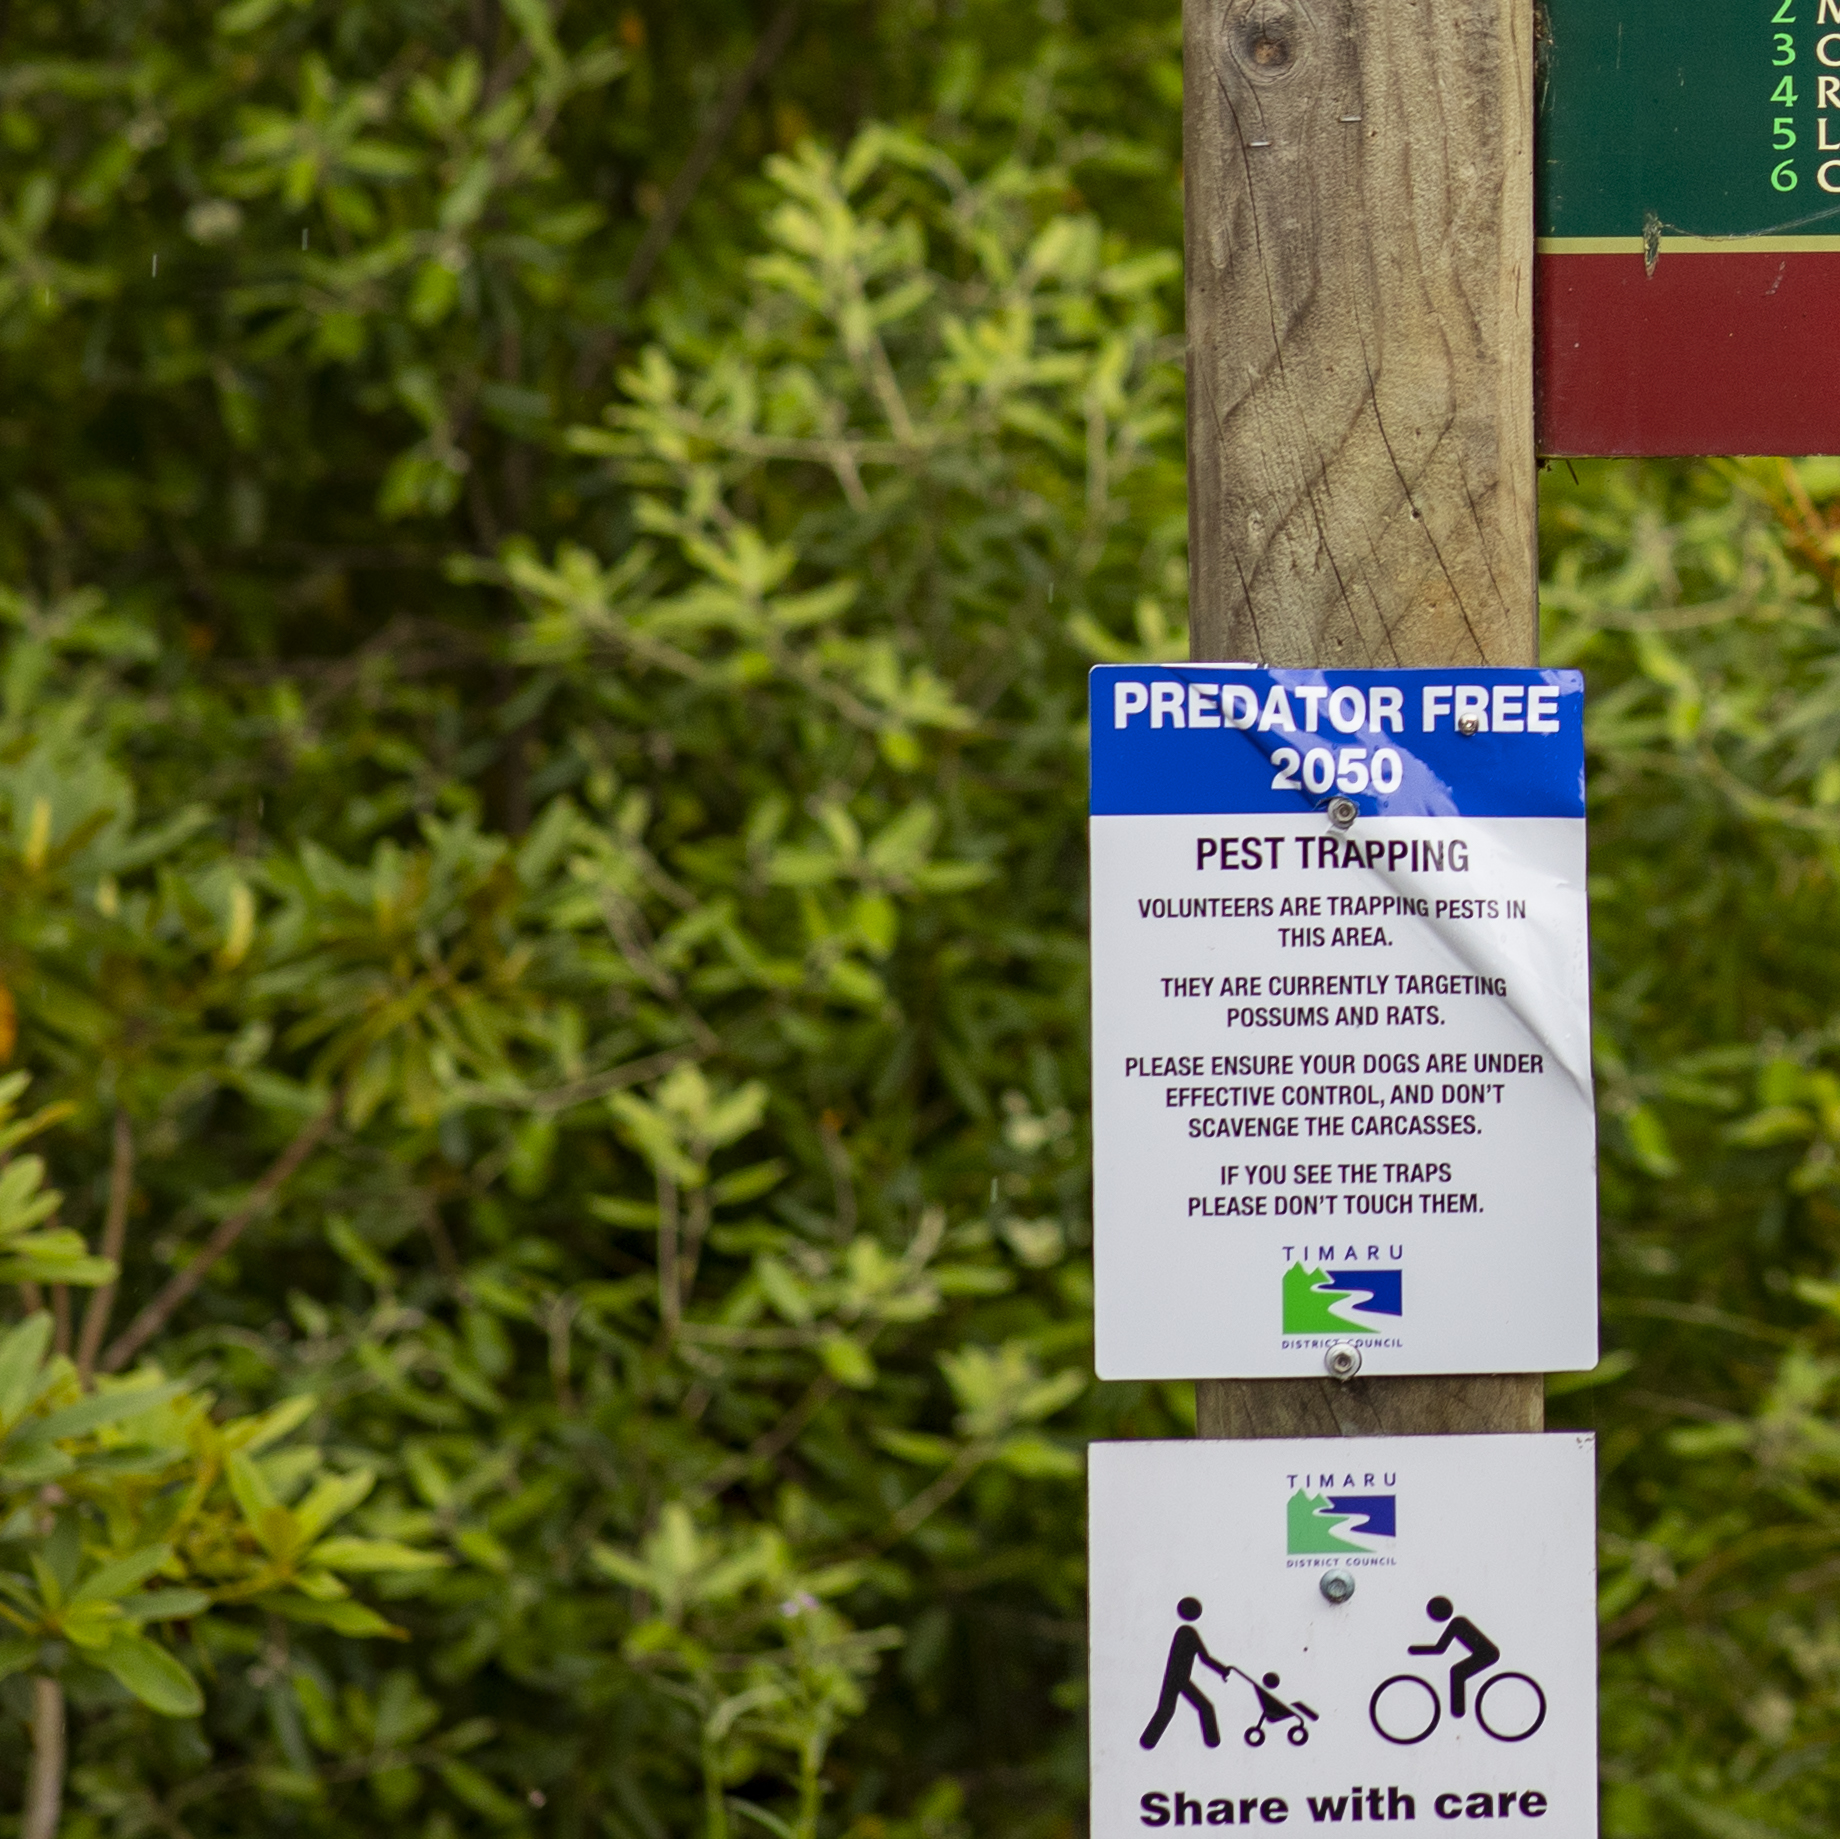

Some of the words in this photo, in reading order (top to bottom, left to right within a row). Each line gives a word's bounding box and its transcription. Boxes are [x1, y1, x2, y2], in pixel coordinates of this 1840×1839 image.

[1771, 32, 1797, 66] 3
[1769, 75, 1799, 108] 4
[1772, 117, 1797, 150] 5
[1770, 159, 1798, 192] 6
[1113, 680, 1405, 734] PREDATOR
[1422, 685, 1560, 733] FREE
[1270, 747, 1403, 795] 2050
[1196, 836, 1285, 871] PEST
[1295, 836, 1470, 873] TRAPPING
[1138, 896, 1275, 919] VOLUNTEERS
[1279, 896, 1322, 917] ARE
[1327, 895, 1429, 918] TRAPPING
[1435, 898, 1503, 919] PESTS
[1507, 900, 1526, 920] IN
[1278, 927, 1326, 948] THIS
[1331, 926, 1393, 947] AREA.
[1161, 976, 1215, 998] THEY
[1220, 976, 1263, 997] ARE
[1268, 975, 1391, 997] CURRENTLY
[1395, 975, 1508, 997] TARGETING
[1226, 1006, 1329, 1028] POSSUMS
[1335, 1005, 1380, 1027] AND
[1385, 1005, 1445, 1027] RATS.
[1125, 1056, 1205, 1078] PLEASE
[1210, 1055, 1294, 1077] ENSURE
[1298, 1054, 1356, 1076] YOUR
[1362, 1053, 1421, 1075] DOGS
[1425, 1053, 1469, 1074] ARE
[1473, 1053, 1544, 1075] UNDER
[1165, 1086, 1276, 1108] EFFECTIVE
[1281, 1084, 1386, 1109] CONTROL,
[1390, 1084, 1435, 1105] AND
[1188, 1117, 1299, 1139] SCAVENGE
[1304, 1116, 1345, 1137] THE
[1350, 1114, 1482, 1136] CARCASSES.
[1220, 1165, 1240, 1185] IF
[1244, 1165, 1289, 1186] YOU
[1293, 1164, 1333, 1185] SEE
[1337, 1163, 1378, 1184] THE
[1382, 1162, 1452, 1184] TRAPS
[1188, 1195, 1268, 1217] PLEASE
[1343, 1194, 1413, 1215] TOUCH
[1418, 1193, 1485, 1215] THEM.
[1282, 1245, 1403, 1261] TIMARU
[1286, 1472, 1397, 1489] TIMARU
[1286, 1558, 1340, 1568] DISTRICT
[1345, 1557, 1397, 1567] COUNCIL
[1139, 1792, 1289, 1828] Share
[1307, 1786, 1416, 1823] with
[1433, 1790, 1549, 1820] care
